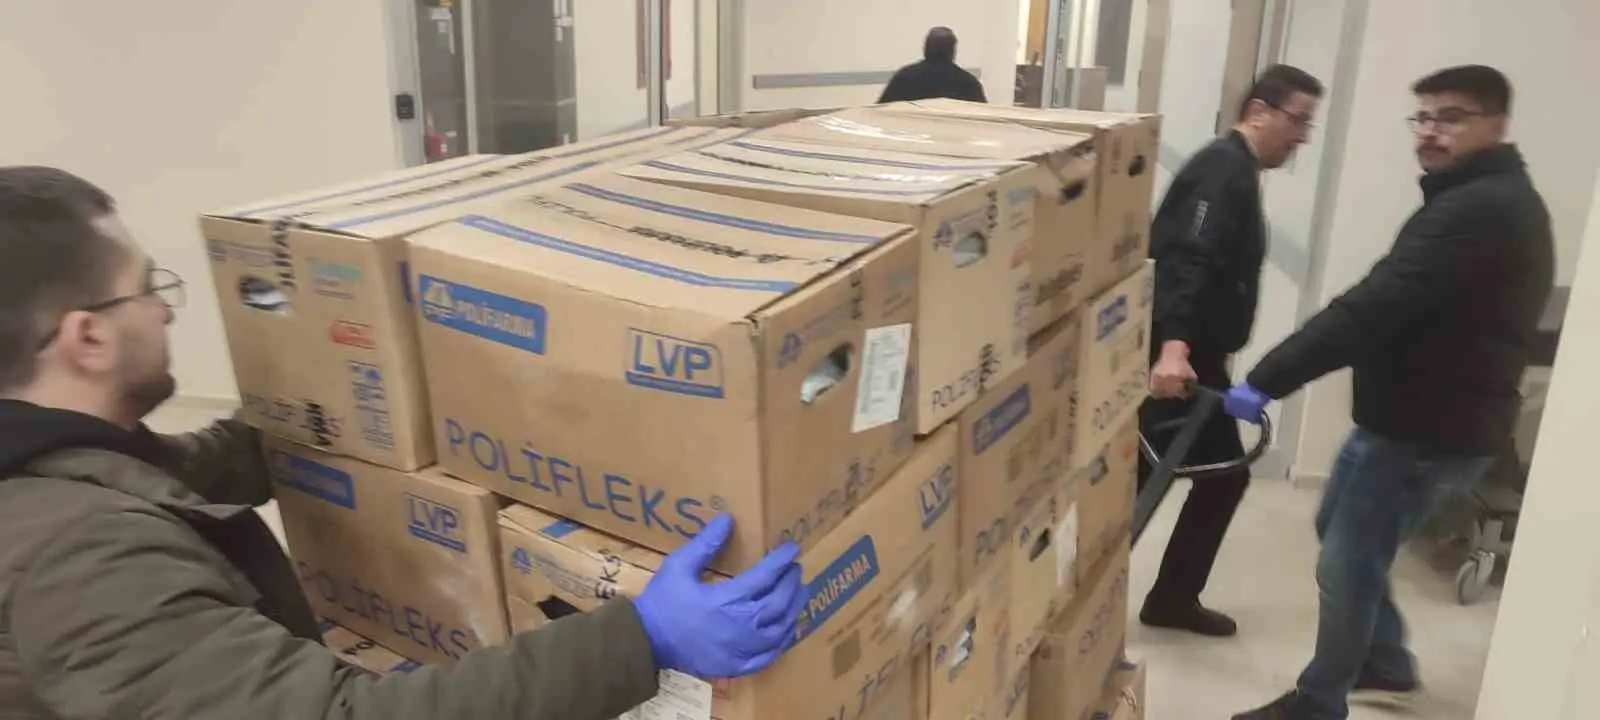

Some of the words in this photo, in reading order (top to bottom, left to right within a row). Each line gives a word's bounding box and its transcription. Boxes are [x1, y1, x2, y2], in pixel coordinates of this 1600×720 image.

[633, 334, 712, 380] LVP
[410, 498, 458, 534] LVP
[808, 552, 872, 620] POLİFARMA
